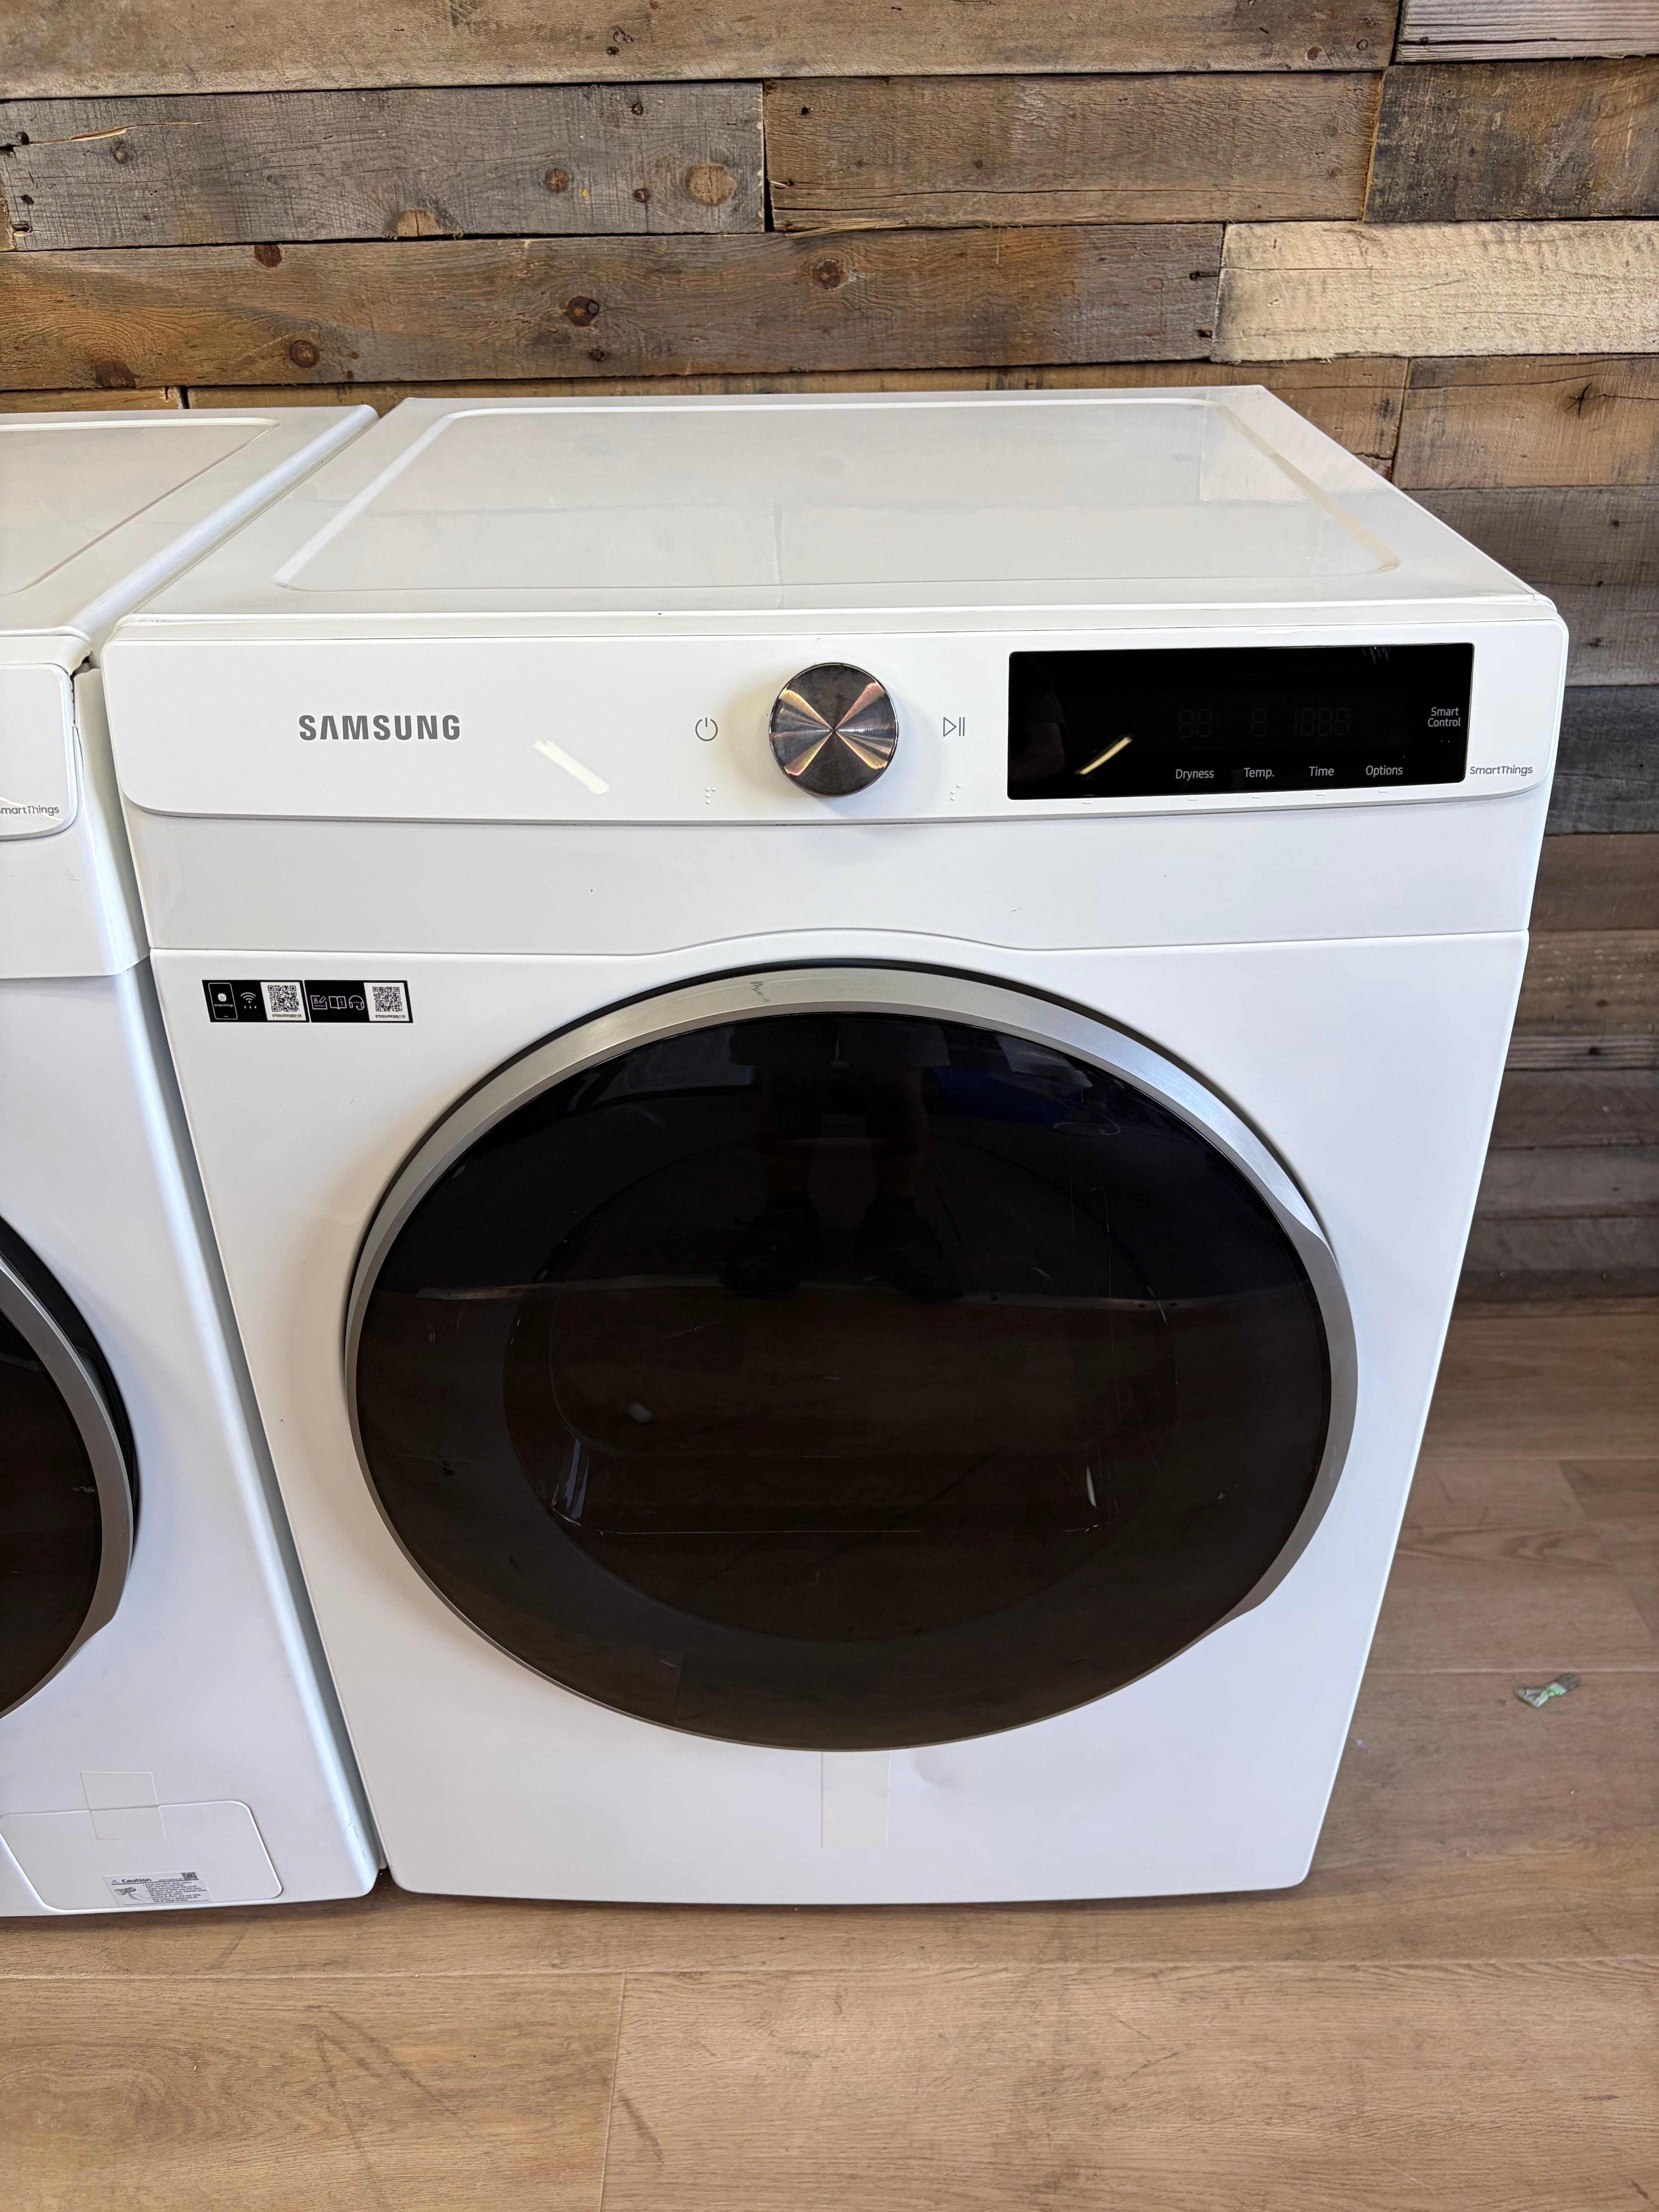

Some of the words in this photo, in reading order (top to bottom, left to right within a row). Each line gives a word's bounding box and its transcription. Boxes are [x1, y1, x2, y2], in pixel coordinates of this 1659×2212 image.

[1431, 707, 1460, 716] Smart
[299, 714, 460, 741] SAMSUNG
[1427, 717, 1461, 727] Control
[1175, 768, 1214, 781] Dryness
[1243, 767, 1275, 780] Temp.
[1309, 766, 1334, 777] Time
[1365, 764, 1403, 778] Options
[1470, 765, 1533, 777] SmartThings
[0, 805, 60, 816] martThings
